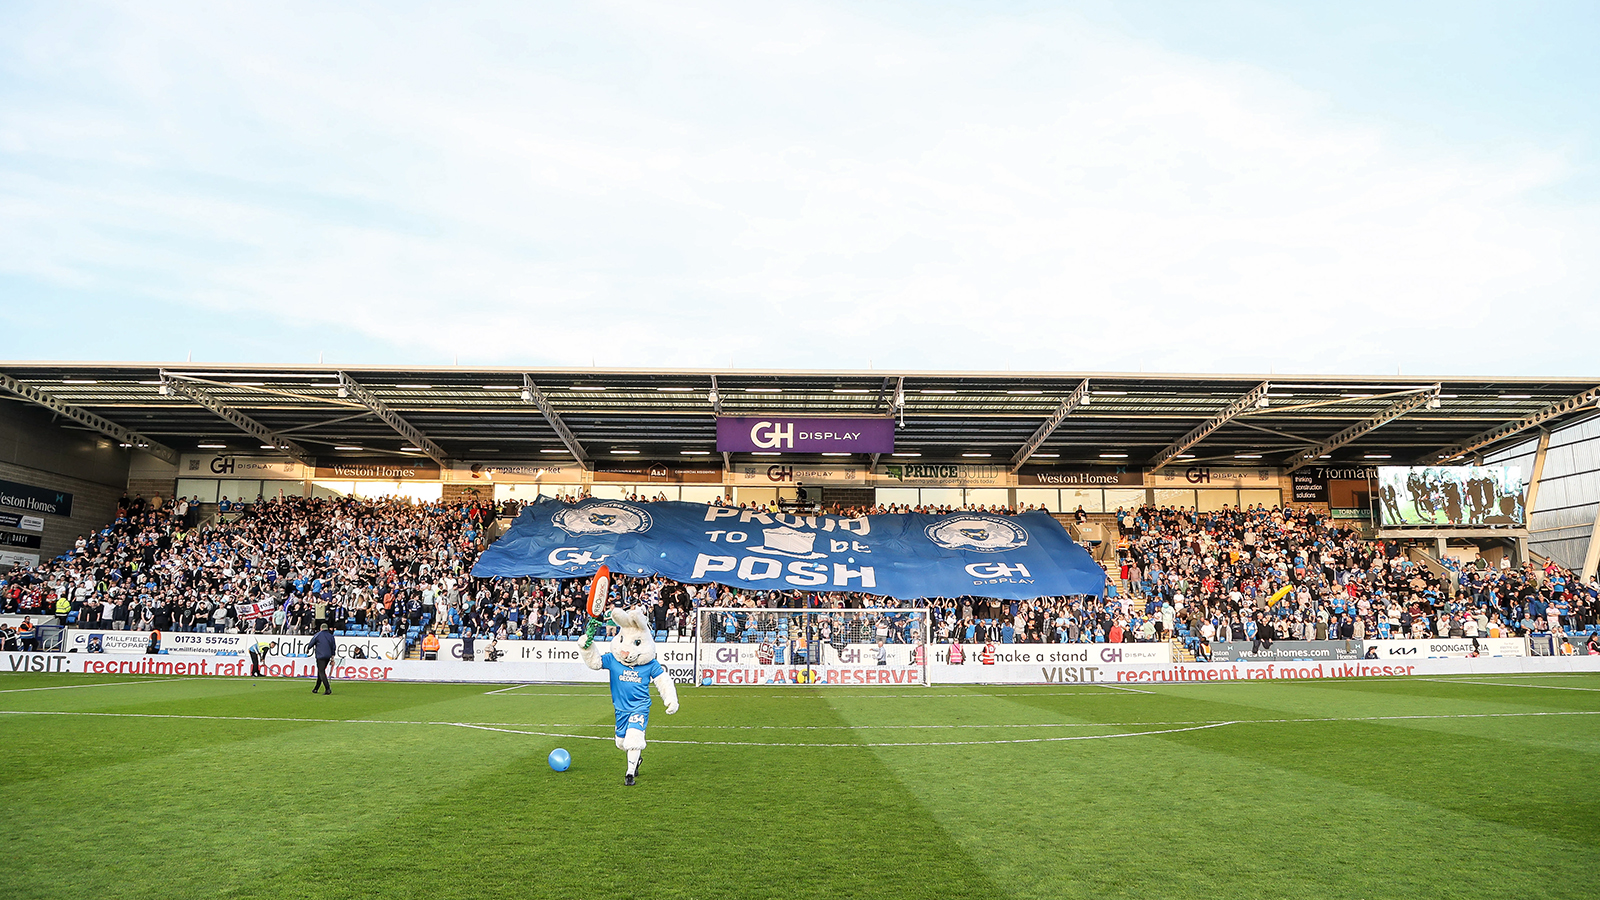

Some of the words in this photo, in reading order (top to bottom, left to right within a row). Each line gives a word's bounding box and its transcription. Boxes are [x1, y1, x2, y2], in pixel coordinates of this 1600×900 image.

[750, 421, 794, 449] GH
[799, 431, 861, 442] DISPLAY
[210, 457, 236, 474] GH
[334, 465, 375, 477] Weston
[376, 466, 415, 477] Homes
[767, 464, 793, 482] GH
[1036, 473, 1080, 484] Weston
[1080, 473, 1119, 484] Homes
[1185, 467, 1210, 484] GH
[1295, 476, 1313, 484] thinking
[0, 491, 27, 508] eston
[27, 496, 58, 514] Homes
[704, 506, 872, 536] PROUD
[705, 530, 749, 544] TO
[690, 552, 878, 589] POSH
[964, 561, 1032, 580] GH
[973, 576, 1036, 587] DISPLAY
[104, 642, 149, 651] AUTOPART
[105, 635, 149, 645] MILLFIELD
[175, 635, 202, 644] 01733
[205, 636, 241, 645] 557457
[268, 637, 315, 658] dalto
[337, 642, 380, 659] eeds
[547, 646, 580, 660] time
[663, 648, 703, 662] stan
[716, 647, 739, 663] GH
[838, 648, 861, 663] GH
[995, 649, 1031, 662] make
[1035, 653, 1044, 662] a
[1049, 649, 1088, 662] stand
[1100, 647, 1122, 663] GH
[1430, 644, 1474, 653] BOONGATE
[9, 654, 71, 673] VISIT:
[84, 656, 393, 680] recruitment.raf.mod.u/reser
[669, 668, 695, 677] ROYA
[1117, 662, 1415, 682] recruitment.raf.mod.uk/reser
[826, 669, 919, 684] RESERVE
